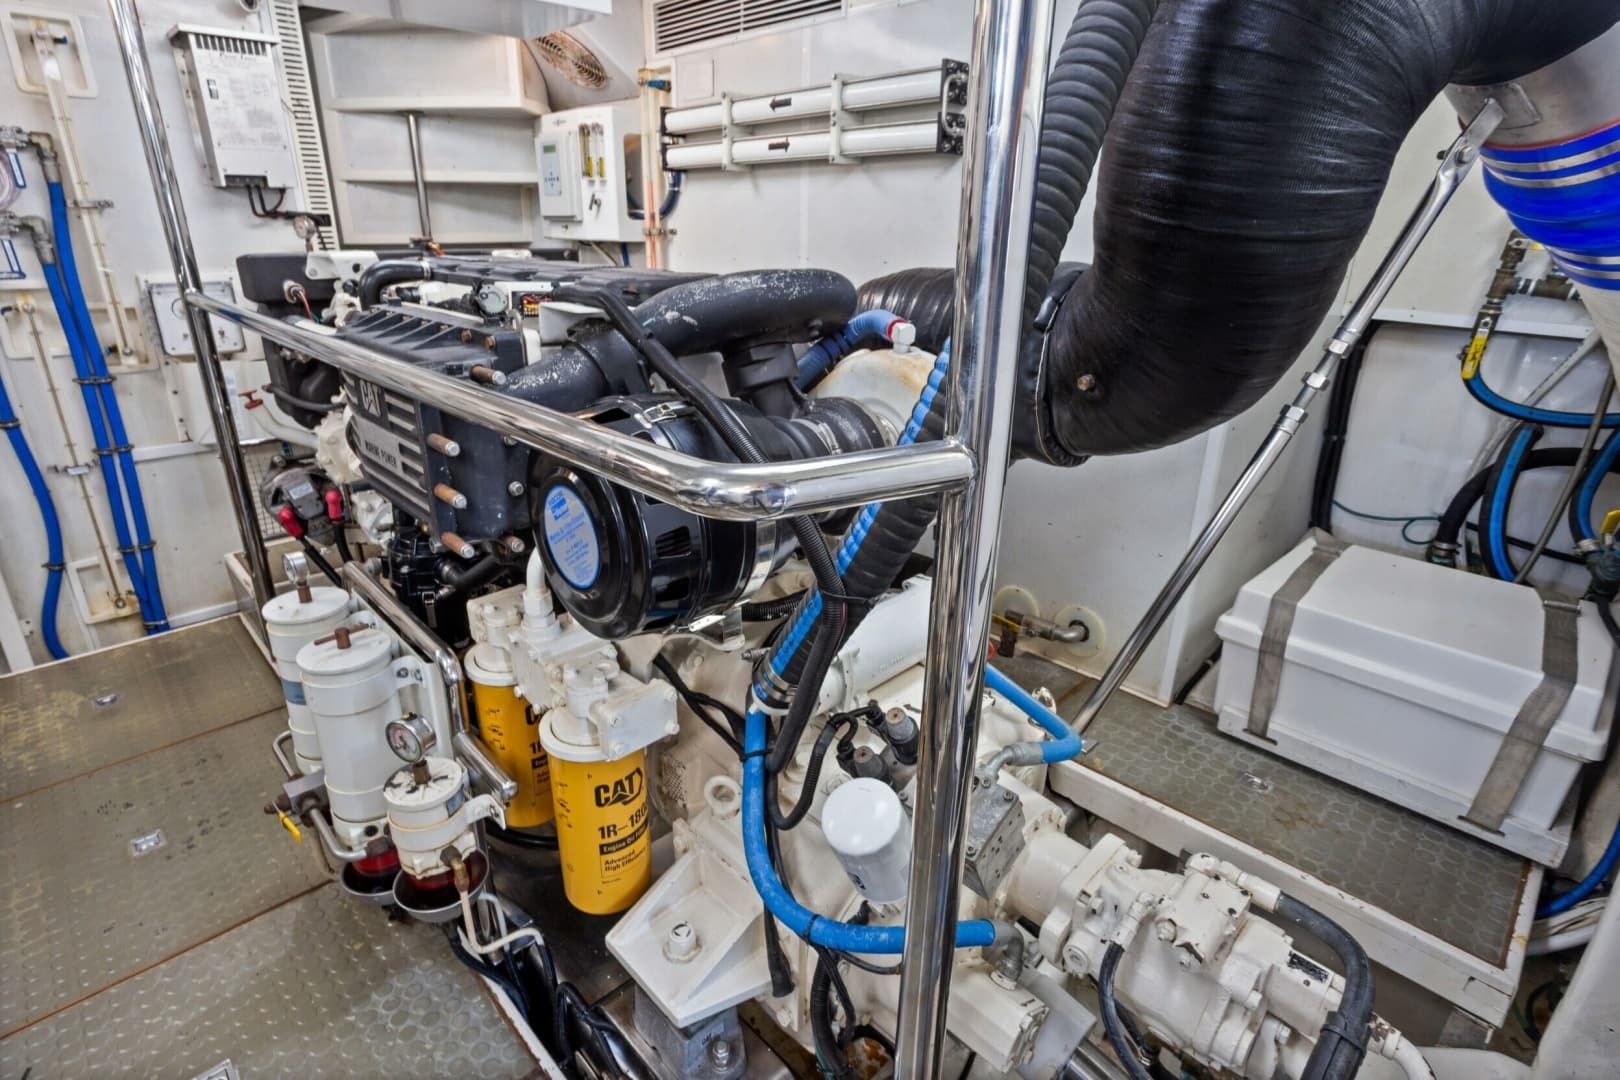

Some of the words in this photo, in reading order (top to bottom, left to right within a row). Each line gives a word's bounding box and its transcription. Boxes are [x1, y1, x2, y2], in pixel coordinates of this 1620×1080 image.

[360, 379, 381, 417] CAT
[594, 768, 643, 808] CAT
[604, 849, 636, 866] Advanced
[604, 862, 621, 873] High
